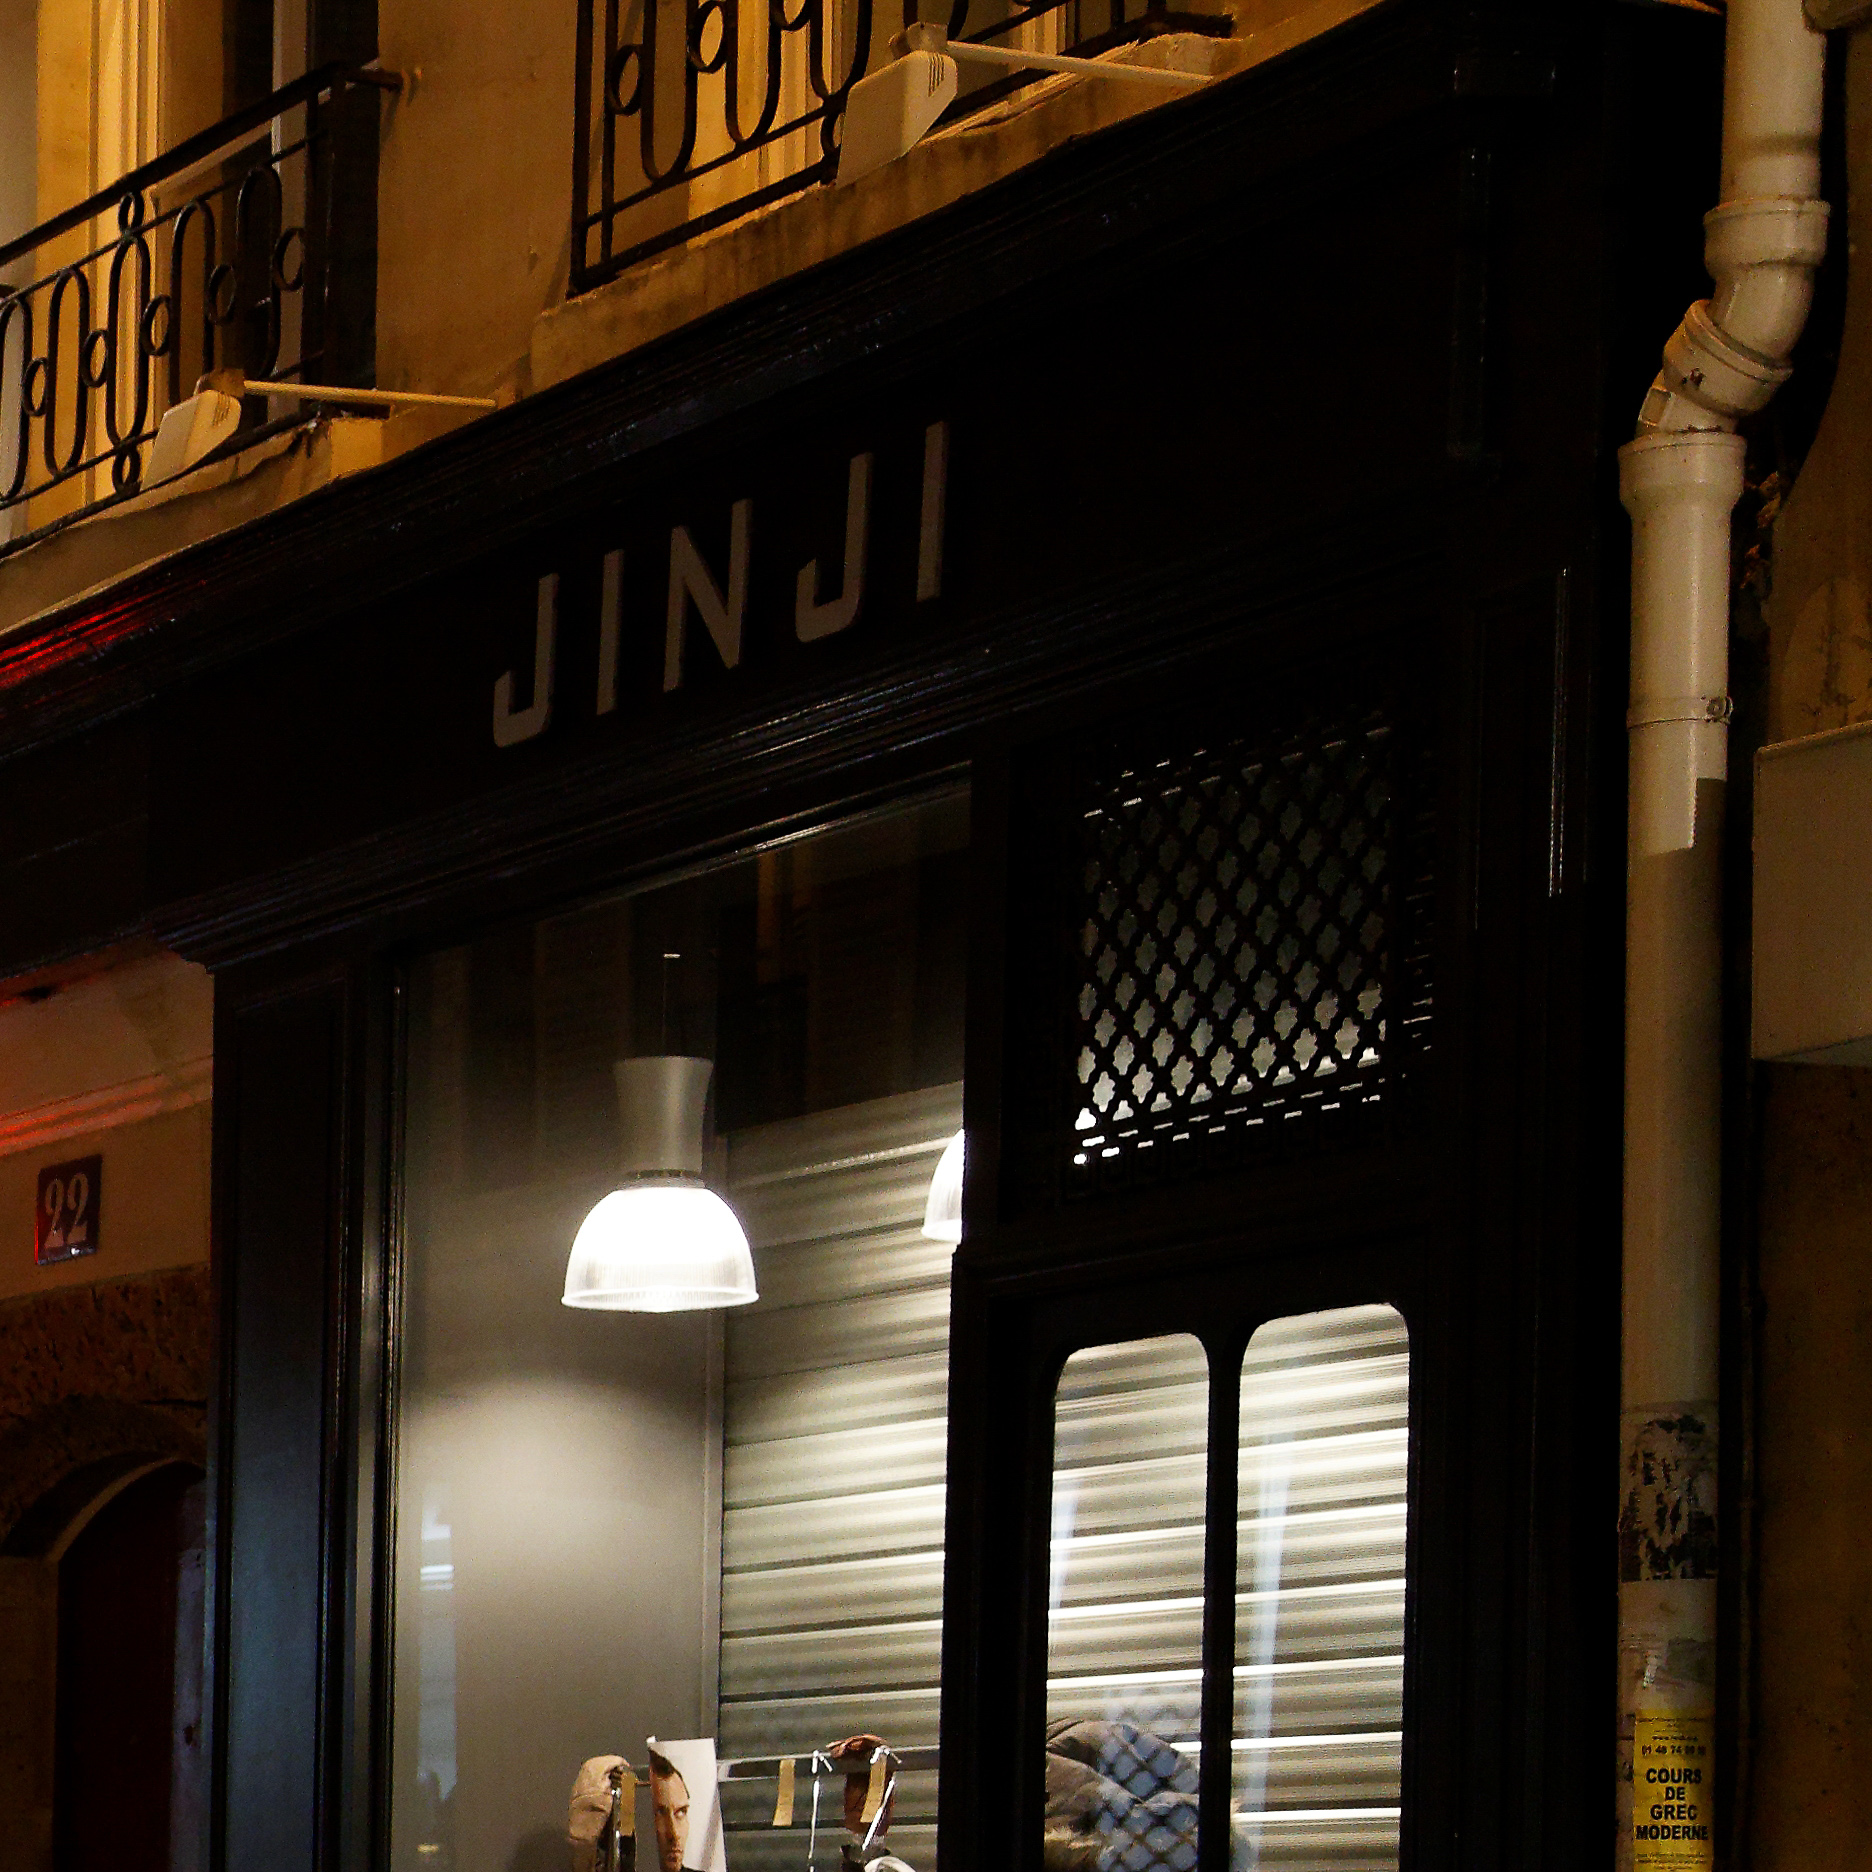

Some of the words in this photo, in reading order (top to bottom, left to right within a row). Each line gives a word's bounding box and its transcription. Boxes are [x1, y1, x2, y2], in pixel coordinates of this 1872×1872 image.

[492, 420, 948, 748] JINJI
[44, 1172, 90, 1249] 22
[1646, 1768, 1702, 1784] COURS
[1665, 1786, 1686, 1801] DE
[1650, 1804, 1698, 1820] GREC
[1636, 1824, 1709, 1841] MODERNE
